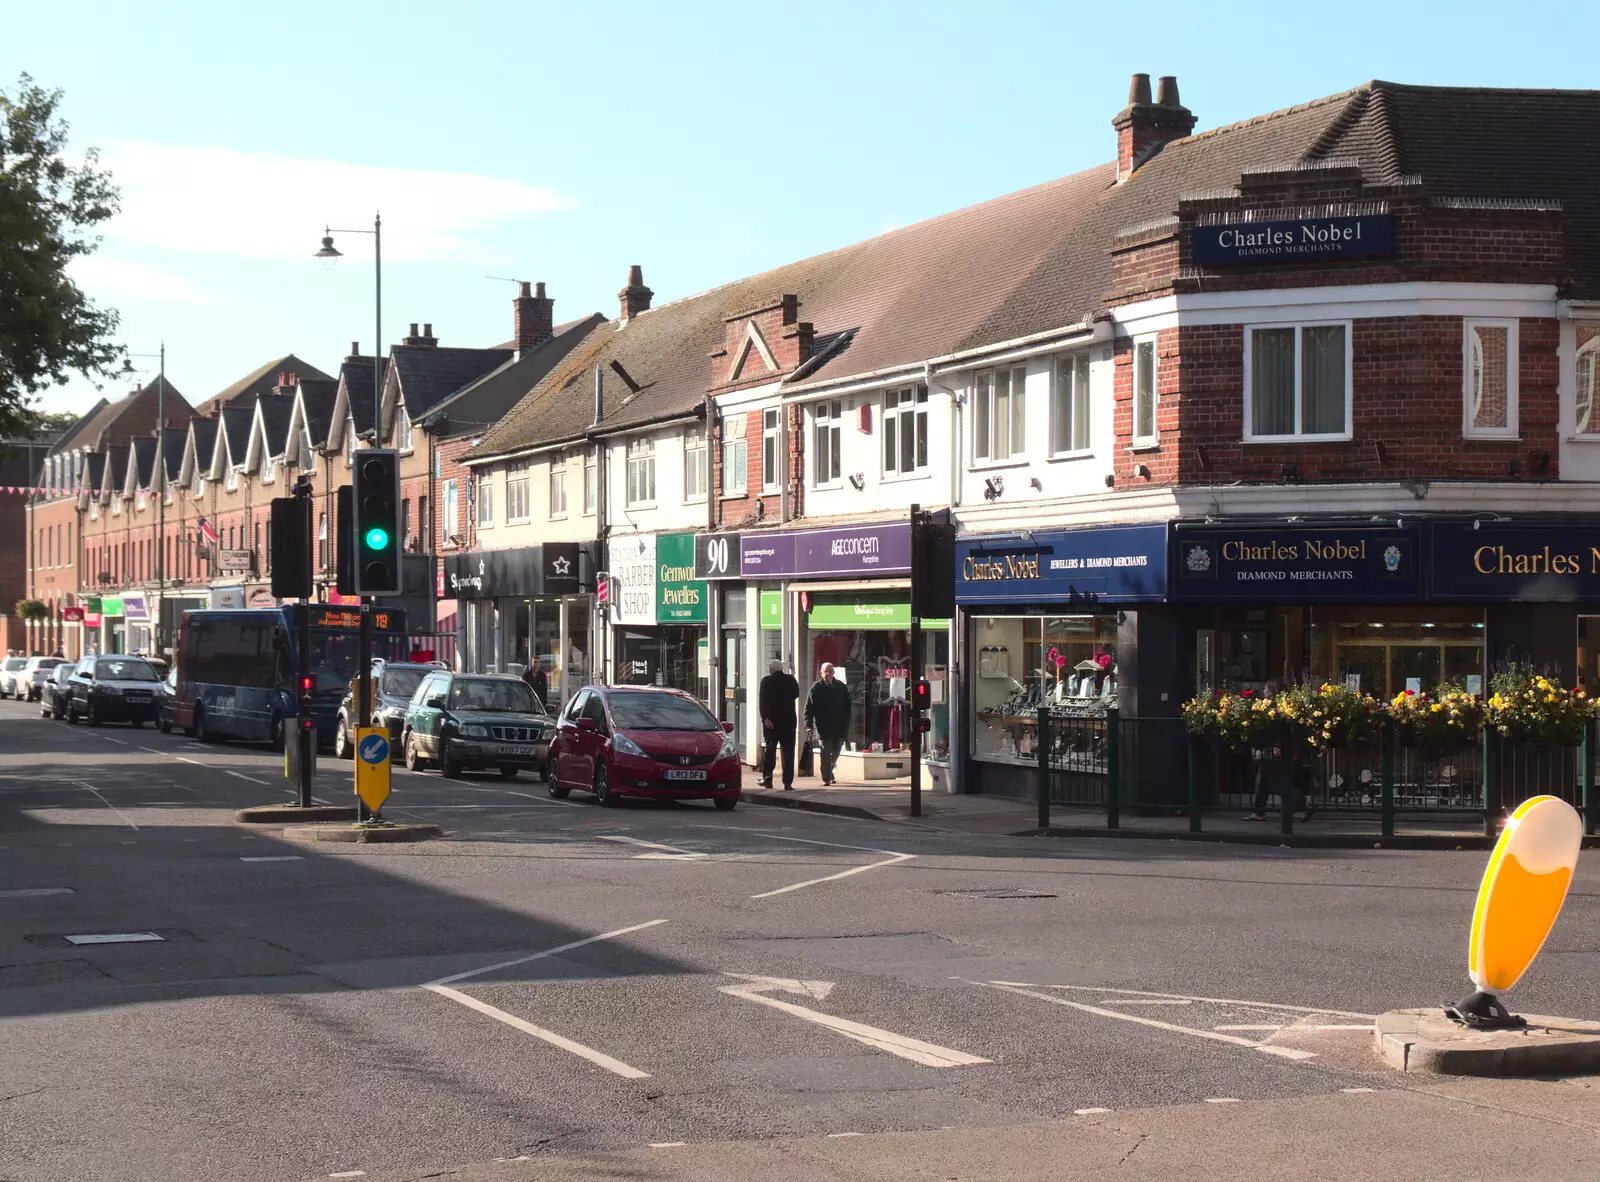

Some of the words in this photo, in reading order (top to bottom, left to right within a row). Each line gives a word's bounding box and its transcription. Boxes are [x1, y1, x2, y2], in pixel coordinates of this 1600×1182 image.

[1218, 227, 1293, 248] Charles
[1301, 221, 1362, 243] Nobel
[1238, 246, 1282, 256] DIAMOND
[1285, 243, 1343, 253] MERCHANTS
[708, 538, 728, 573] 90
[1222, 540, 1299, 561] Charles
[1303, 539, 1367, 560] Nobel
[1474, 545, 1580, 574] Charles
[963, 555, 1003, 581] Charles
[1005, 553, 1041, 580] Nobel
[1050, 558, 1078, 570] JEWELLERS
[1079, 559, 1085, 569] &
[1086, 557, 1112, 568] DIAMOND
[1113, 555, 1147, 567] MERCHANTS
[618, 564, 655, 587] BARBER
[1237, 571, 1286, 580] DIAMOND
[1290, 570, 1353, 580] MERCHANTS
[623, 592, 650, 614] SHOP
[662, 585, 699, 605] Jewellers
[375, 613, 389, 629] 119
[885, 668, 908, 679] SALE
[670, 770, 688, 780] LR13
[689, 770, 705, 781] DFA
